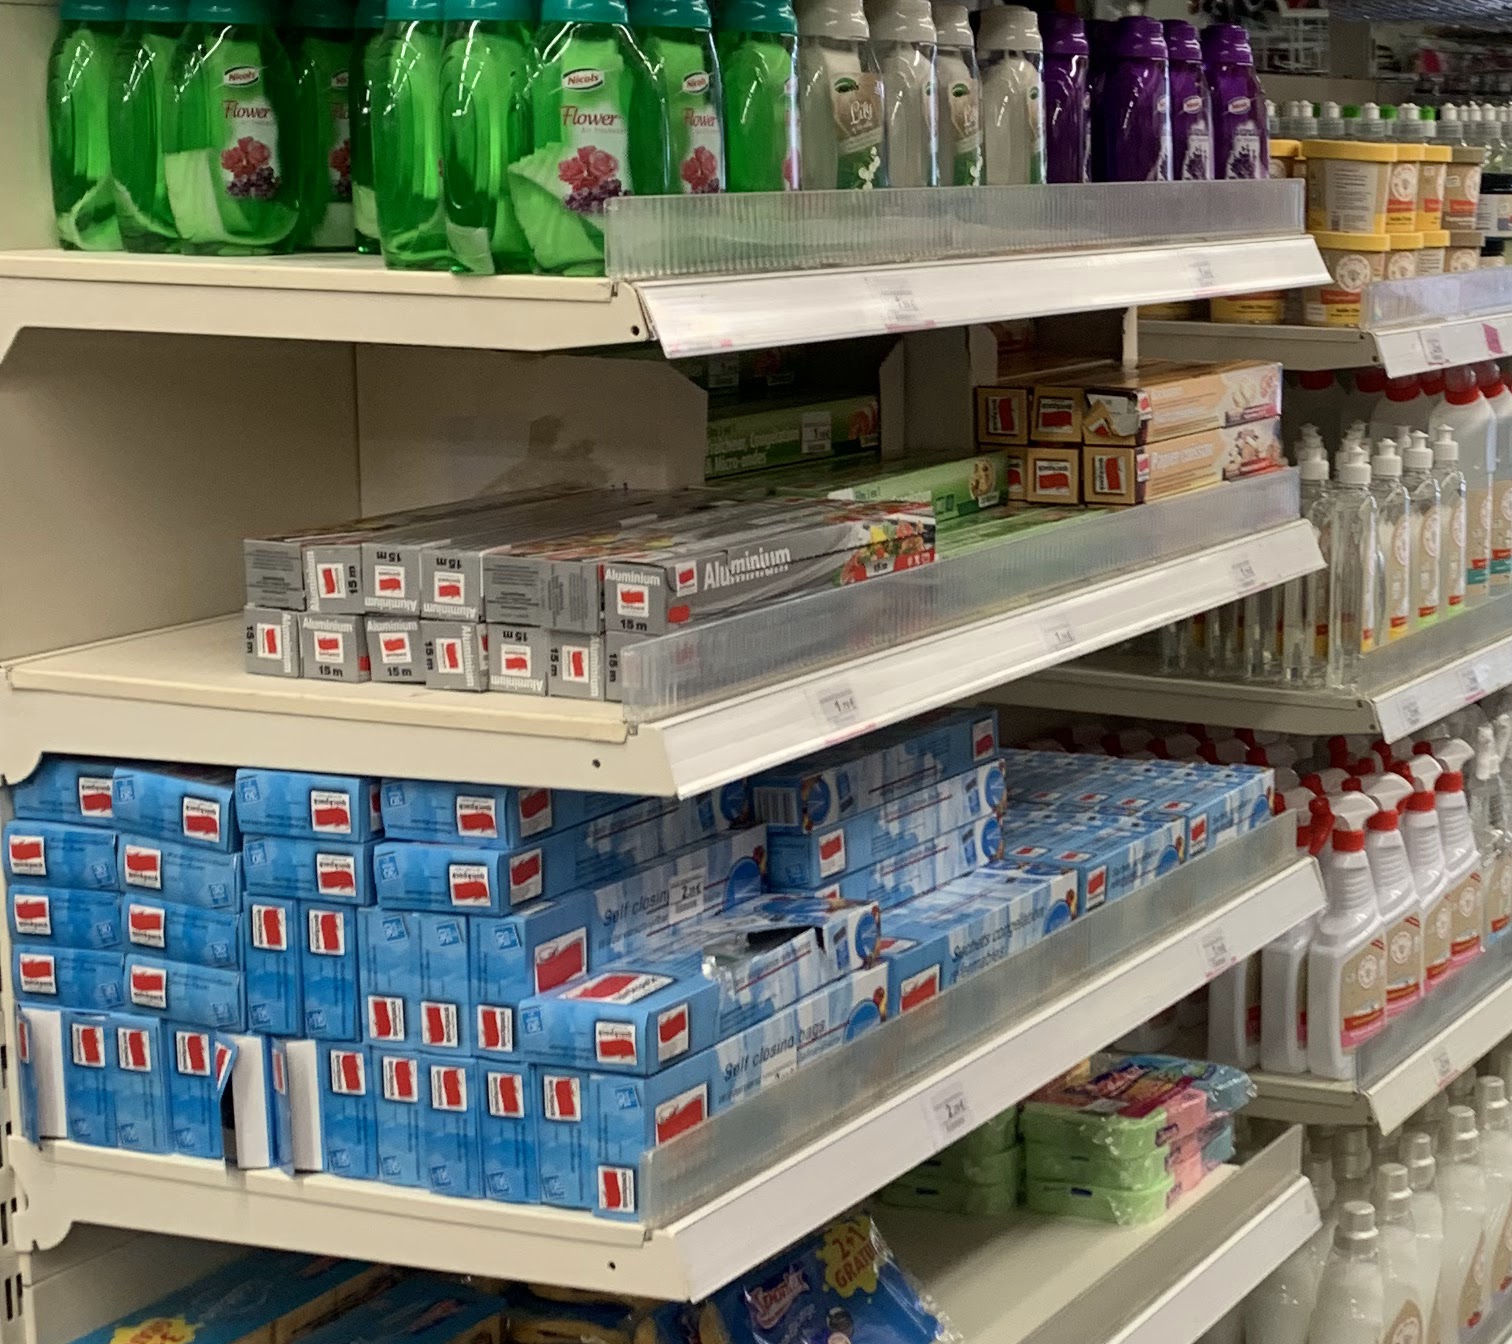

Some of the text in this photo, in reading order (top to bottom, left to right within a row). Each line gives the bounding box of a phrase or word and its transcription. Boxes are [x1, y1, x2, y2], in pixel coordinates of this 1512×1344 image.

[567, 73, 600, 86] Nicols
[223, 100, 270, 119] Flower
[561, 105, 618, 128] Flower
[683, 107, 717, 127] Flower
[389, 551, 401, 562] 15
[448, 558, 462, 570] 15
[605, 568, 660, 586] Aluminium
[703, 546, 791, 592] Aluminium
[306, 550, 319, 612] Aluminium
[364, 596, 418, 612] Aluminium
[423, 602, 477, 619] Aluminium
[303, 616, 353, 633] Aluminium
[367, 618, 418, 632] Aluminium
[620, 619, 648, 632] 15 m
[514, 632, 528, 641] 15
[425, 641, 433, 657] 15
[462, 625, 475, 687] Aluminium
[551, 648, 559, 662] 15
[318, 666, 343, 677] 15 m
[387, 666, 412, 677] 15 m
[490, 675, 544, 692] Aluminium
[603, 888, 669, 927] Self closin
[723, 1054, 750, 1083] Self
[832, 1226, 866, 1253] 2+1
